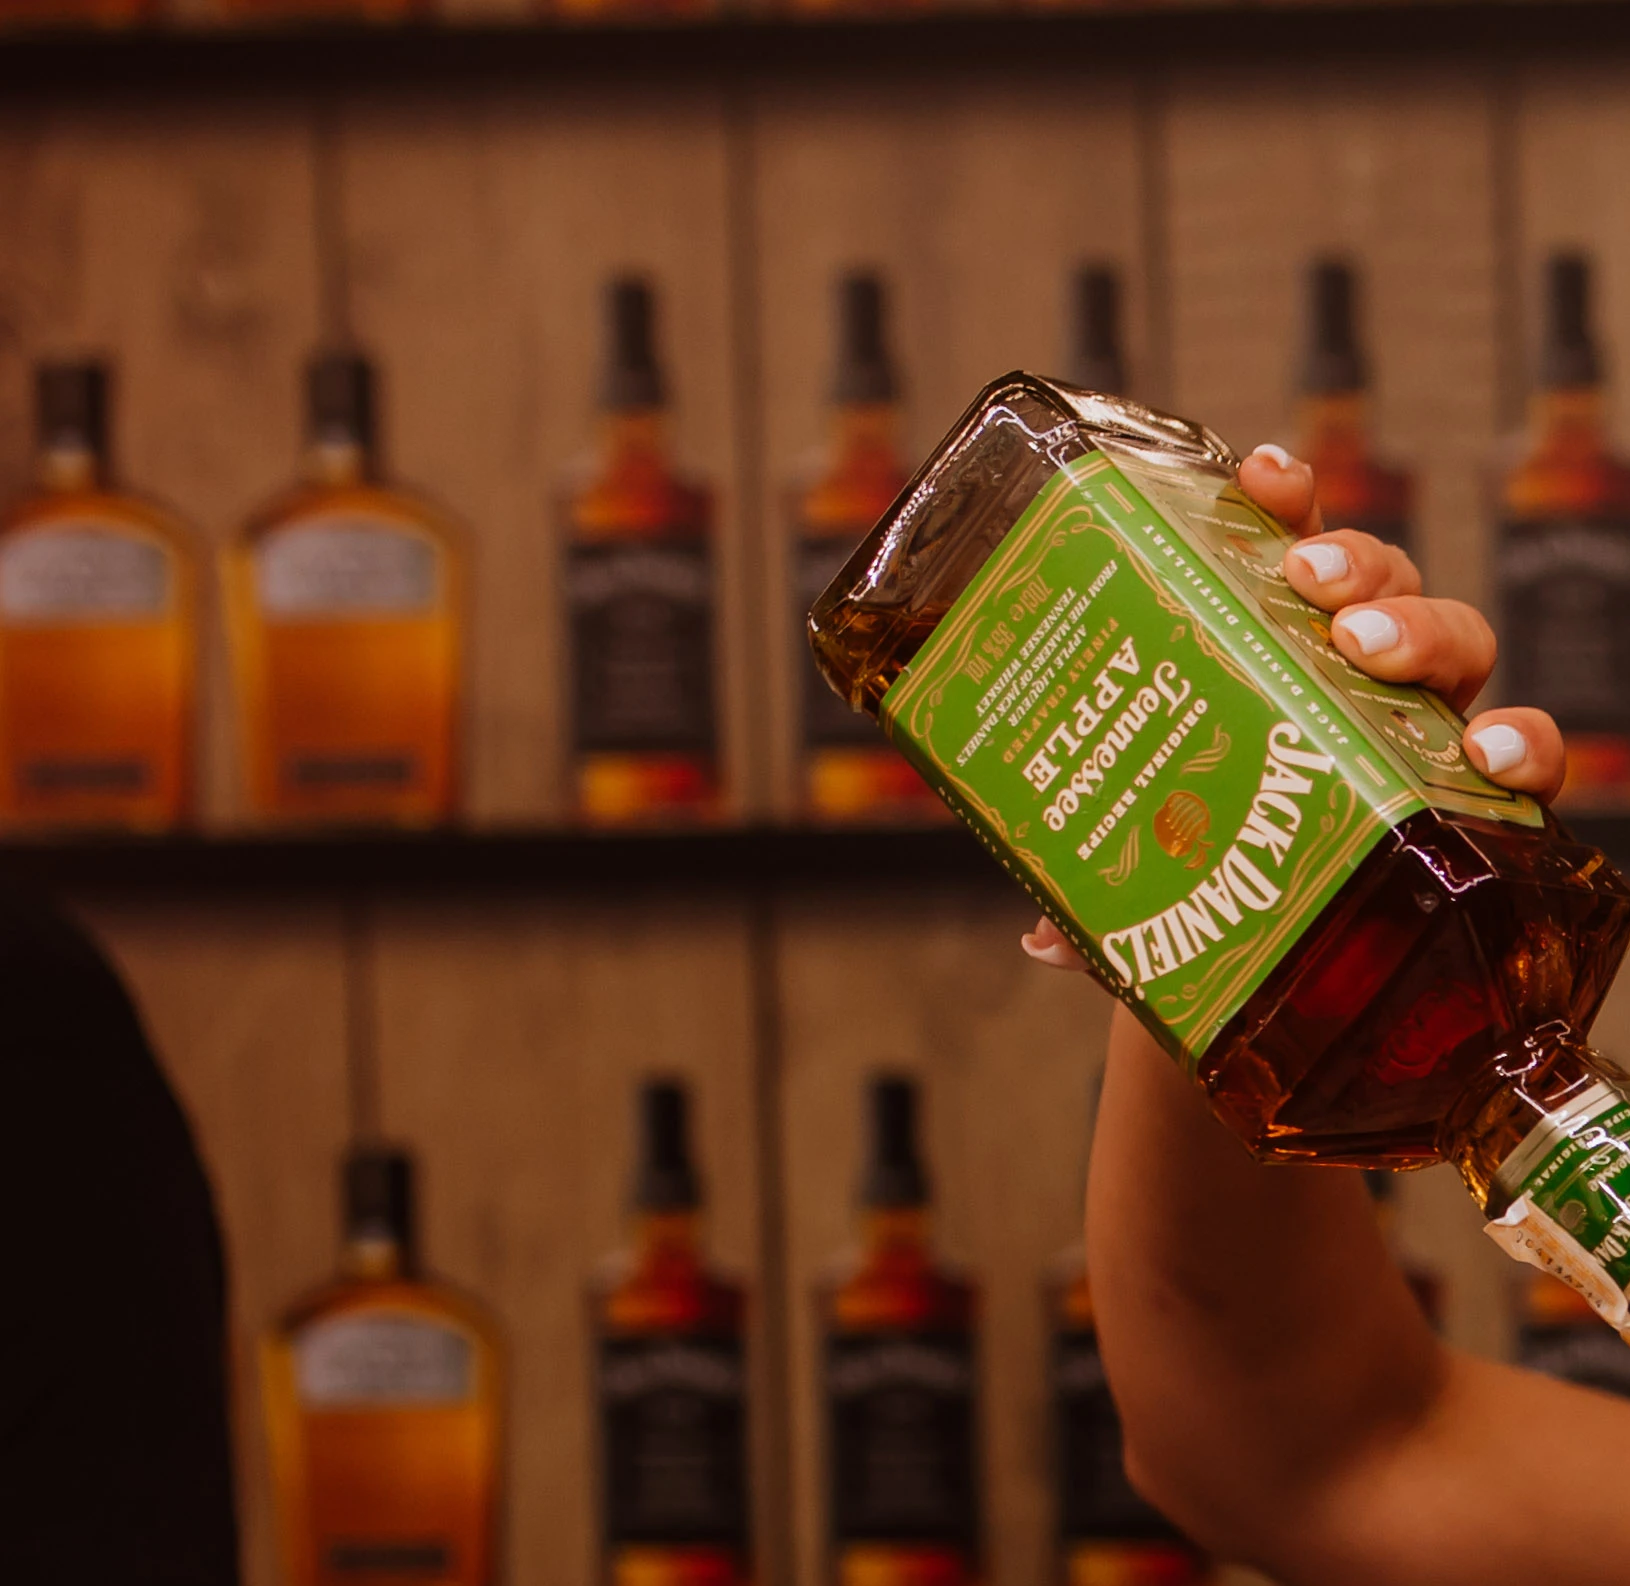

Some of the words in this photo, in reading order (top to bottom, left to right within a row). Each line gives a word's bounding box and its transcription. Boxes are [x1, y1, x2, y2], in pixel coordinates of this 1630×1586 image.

[1020, 574, 1053, 615] 70cl
[1088, 560, 1118, 597] FROM
[1141, 521, 1239, 626] DISTILLERY
[1019, 586, 1076, 660] TENNESSEE
[1069, 594, 1091, 624] THE
[981, 620, 1017, 661] 35%
[1031, 620, 1071, 672] MAKERS
[1053, 624, 1087, 669] APPLE
[1068, 617, 1119, 683] FINELY
[1239, 629, 1305, 697] DANIEL
[975, 658, 1022, 717] WHISKEY
[996, 679, 1021, 717] JACK
[1008, 668, 1055, 727] LIQUEUR
[1019, 670, 1033, 688] OF
[956, 713, 999, 767] DANIEL'S
[1003, 684, 1067, 764] CRAFTED
[1021, 637, 1142, 793] APPLE
[1130, 695, 1210, 790] ORIGINAL
[1303, 700, 1350, 746] JACK
[1042, 660, 1191, 832] Tennessee
[1237, 721, 1335, 867] JACK
[1074, 787, 1137, 862] RECIPE
[1101, 843, 1282, 1001] DANIEL'S
